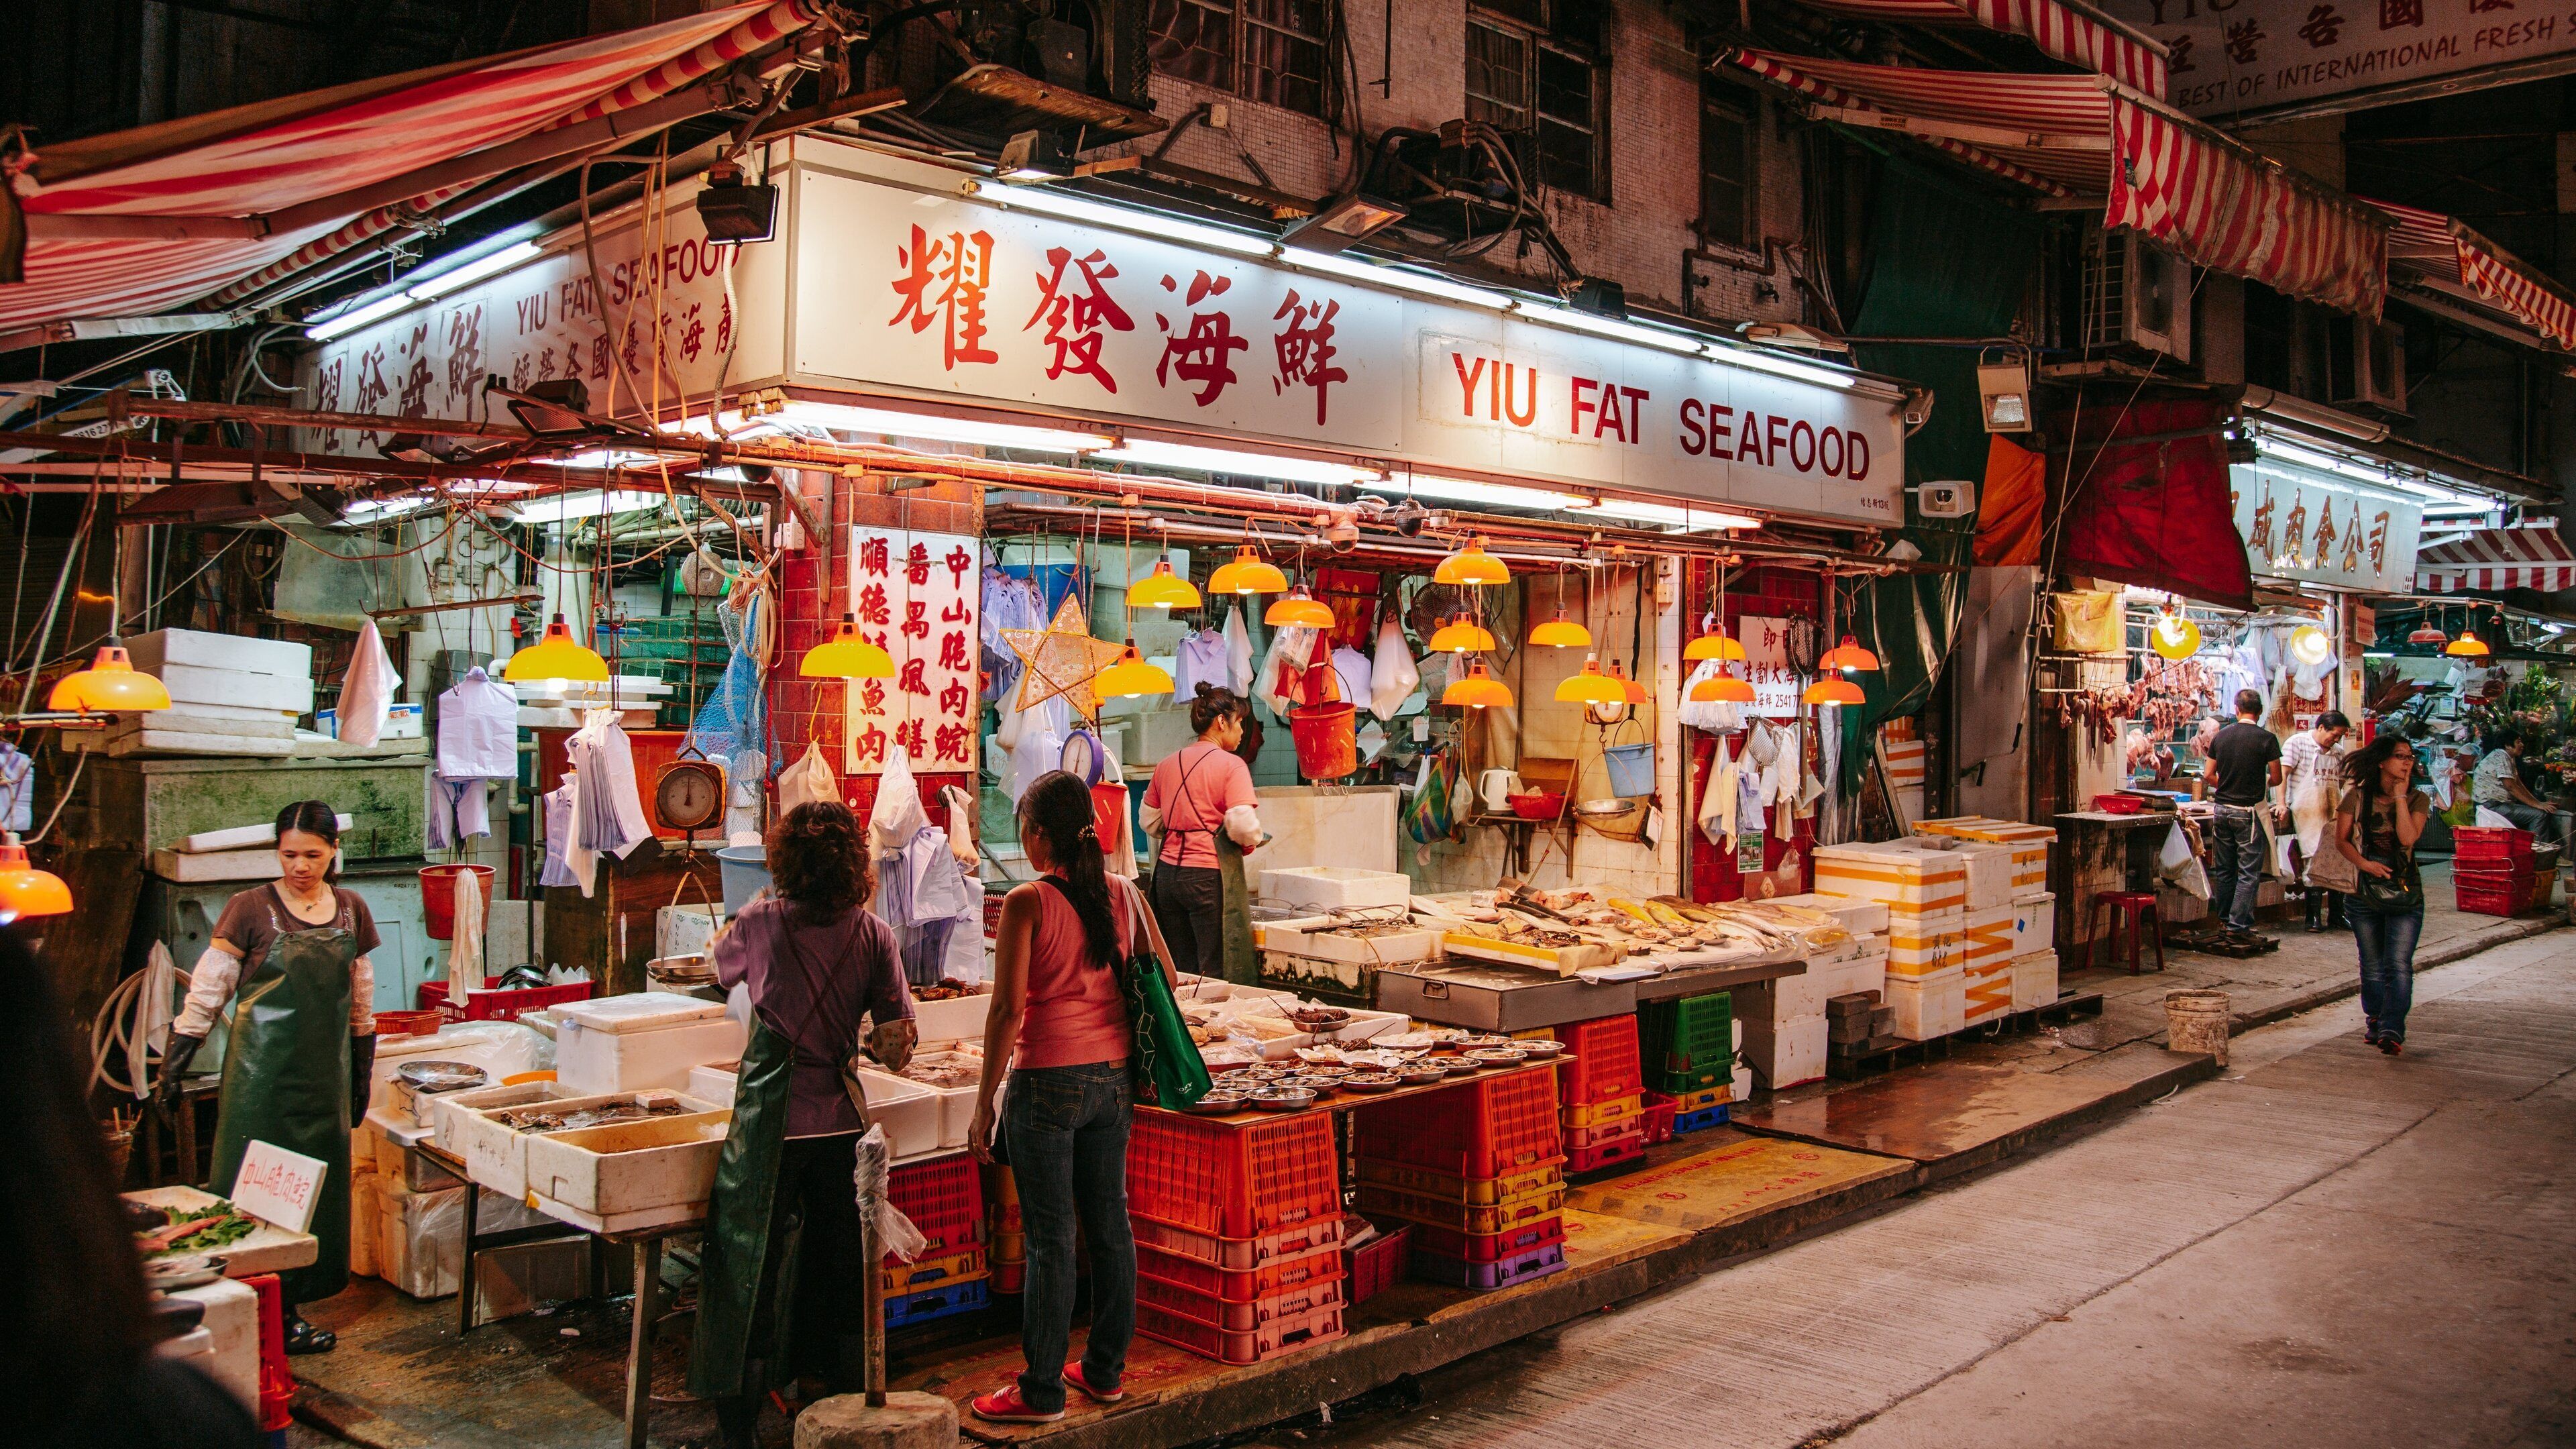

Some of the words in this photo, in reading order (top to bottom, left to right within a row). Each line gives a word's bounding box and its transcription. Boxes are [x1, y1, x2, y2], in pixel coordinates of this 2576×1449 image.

[2180, 80, 2227, 109] BEST
[2237, 71, 2267, 97] OF
[2276, 35, 2461, 91] INTERNATIONAL
[2474, 15, 2556, 52] FRESH
[517, 290, 548, 335] YIU
[888, 222, 1348, 426] 耀發海鮮
[1450, 351, 1537, 428] YIU
[1570, 376, 1650, 445] FAT
[1679, 397, 1870, 482] SEAFOOD
